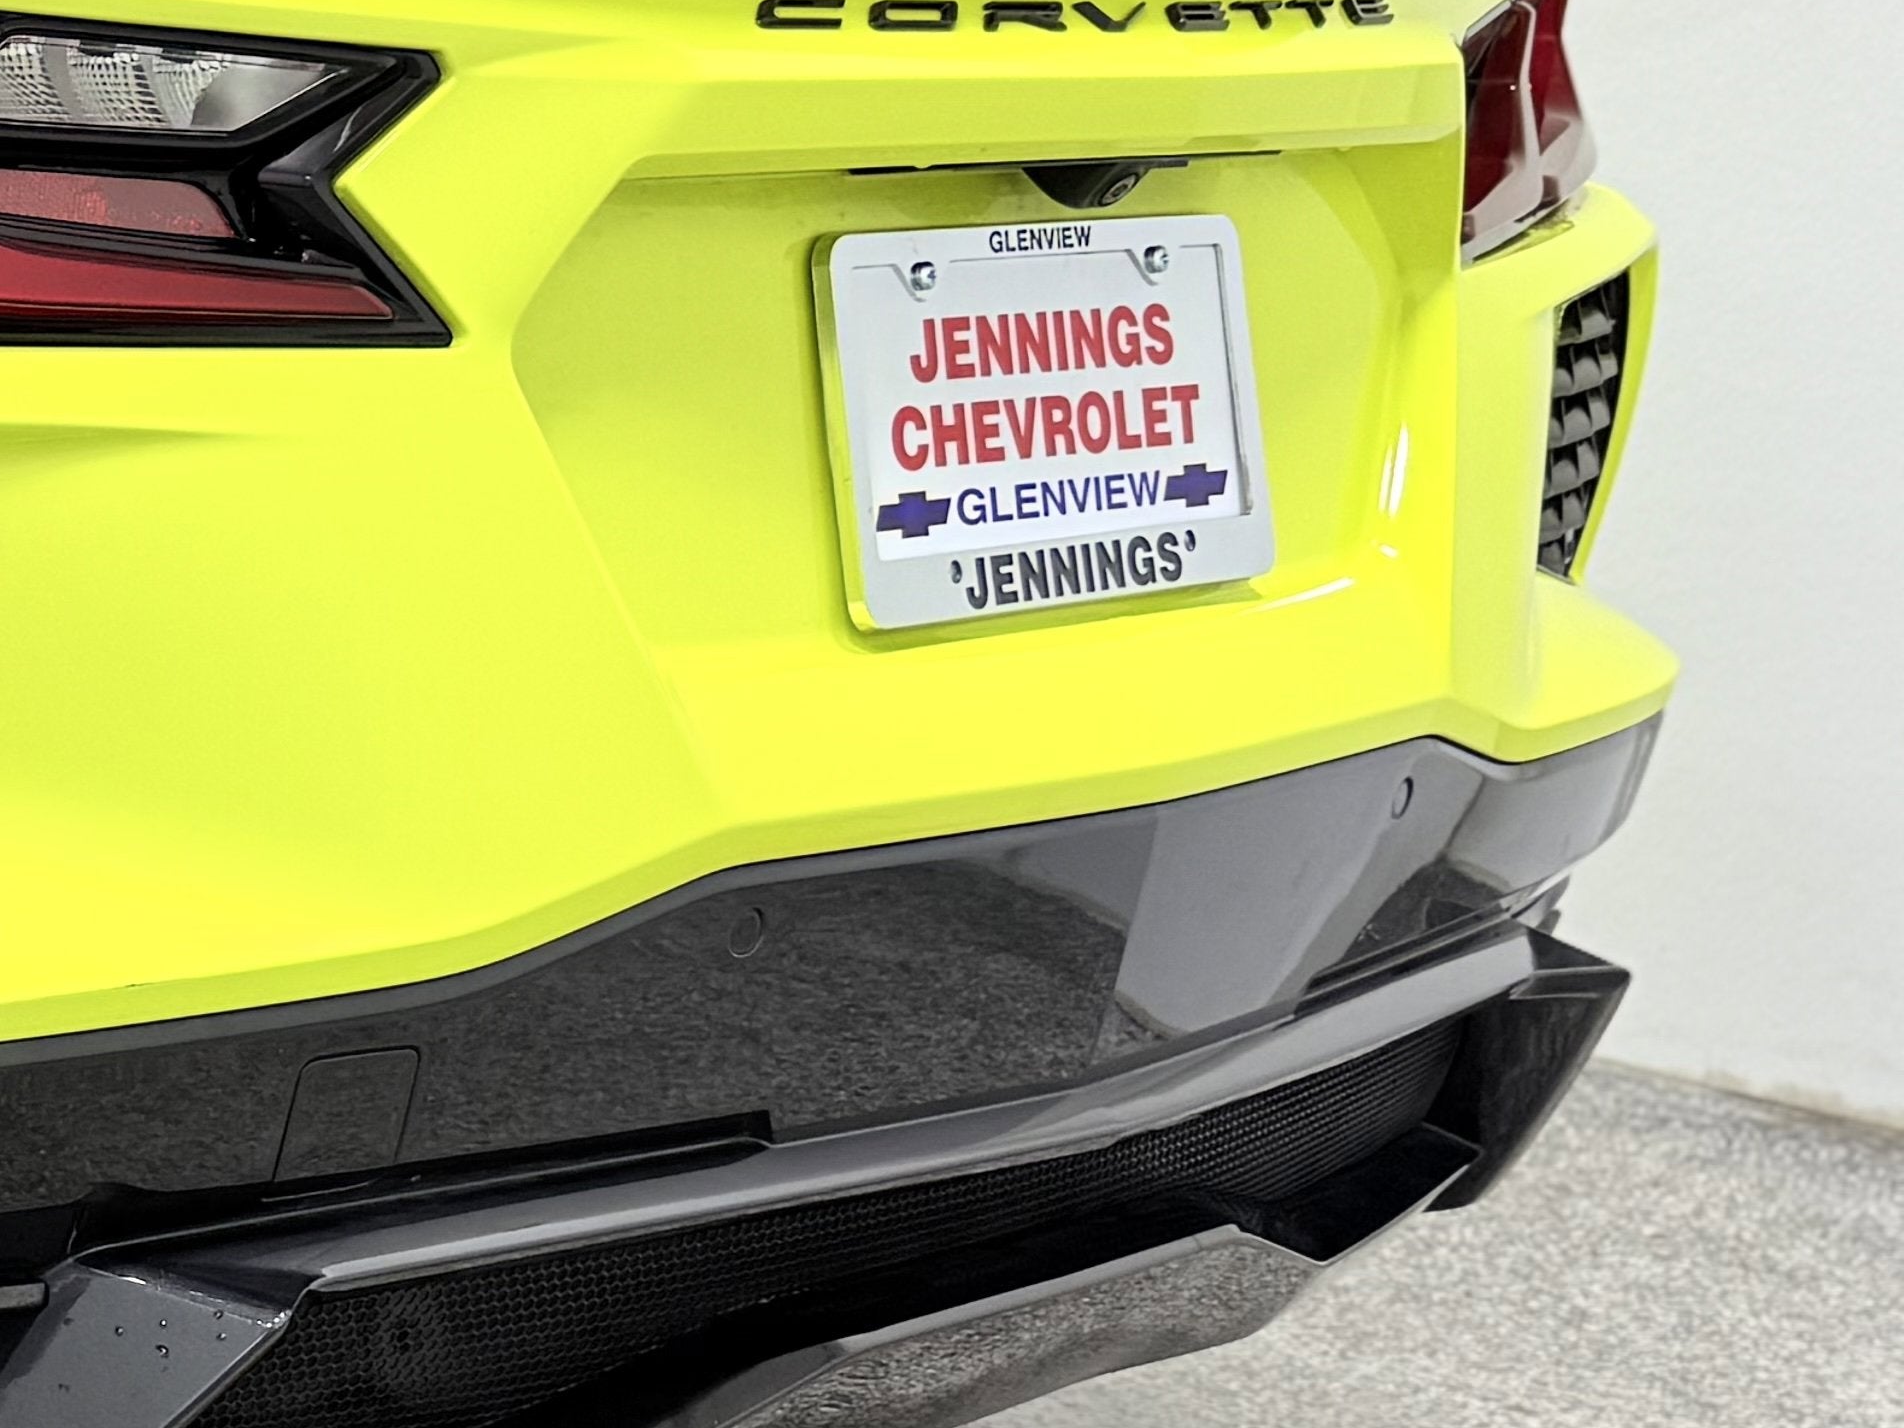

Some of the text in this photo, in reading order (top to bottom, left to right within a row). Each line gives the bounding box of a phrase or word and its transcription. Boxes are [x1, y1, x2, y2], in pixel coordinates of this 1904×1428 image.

[988, 225, 1092, 254] GLENVIEW
[910, 303, 1174, 383] JENNINGS
[892, 384, 1200, 472] CHEVROLET
[956, 471, 1161, 526] GLENVIEW
